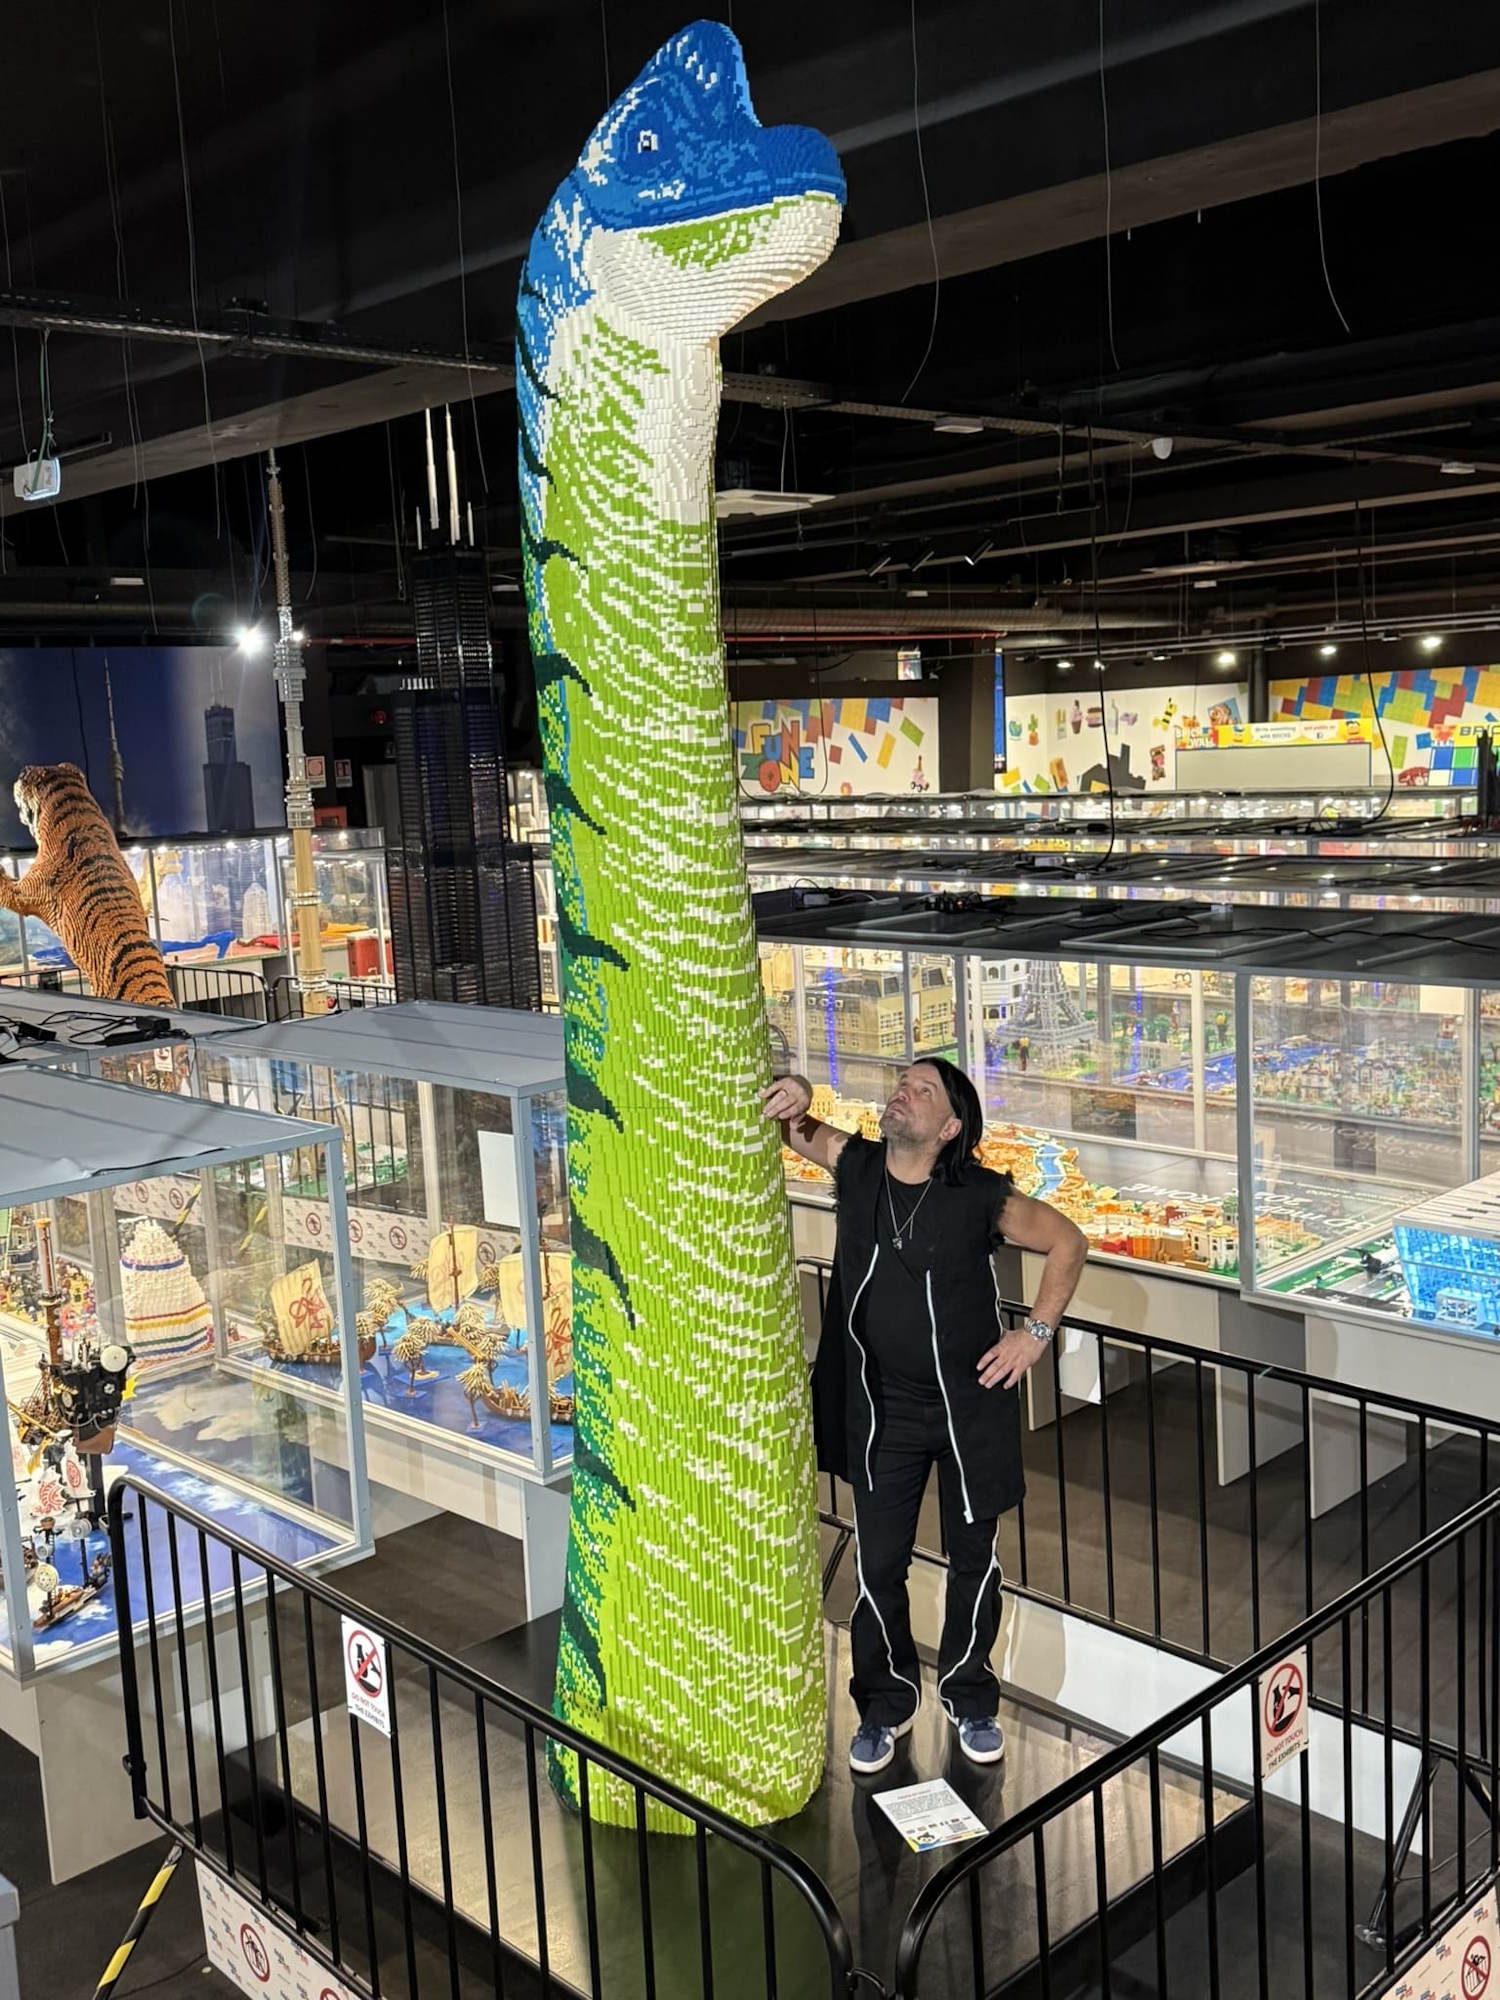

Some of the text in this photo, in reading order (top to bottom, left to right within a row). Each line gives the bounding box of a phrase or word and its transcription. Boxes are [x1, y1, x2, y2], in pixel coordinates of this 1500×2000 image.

[750, 719, 800, 768] FUN
[740, 747, 815, 792] ZONE
[1120, 1183, 1222, 1203] ROME
